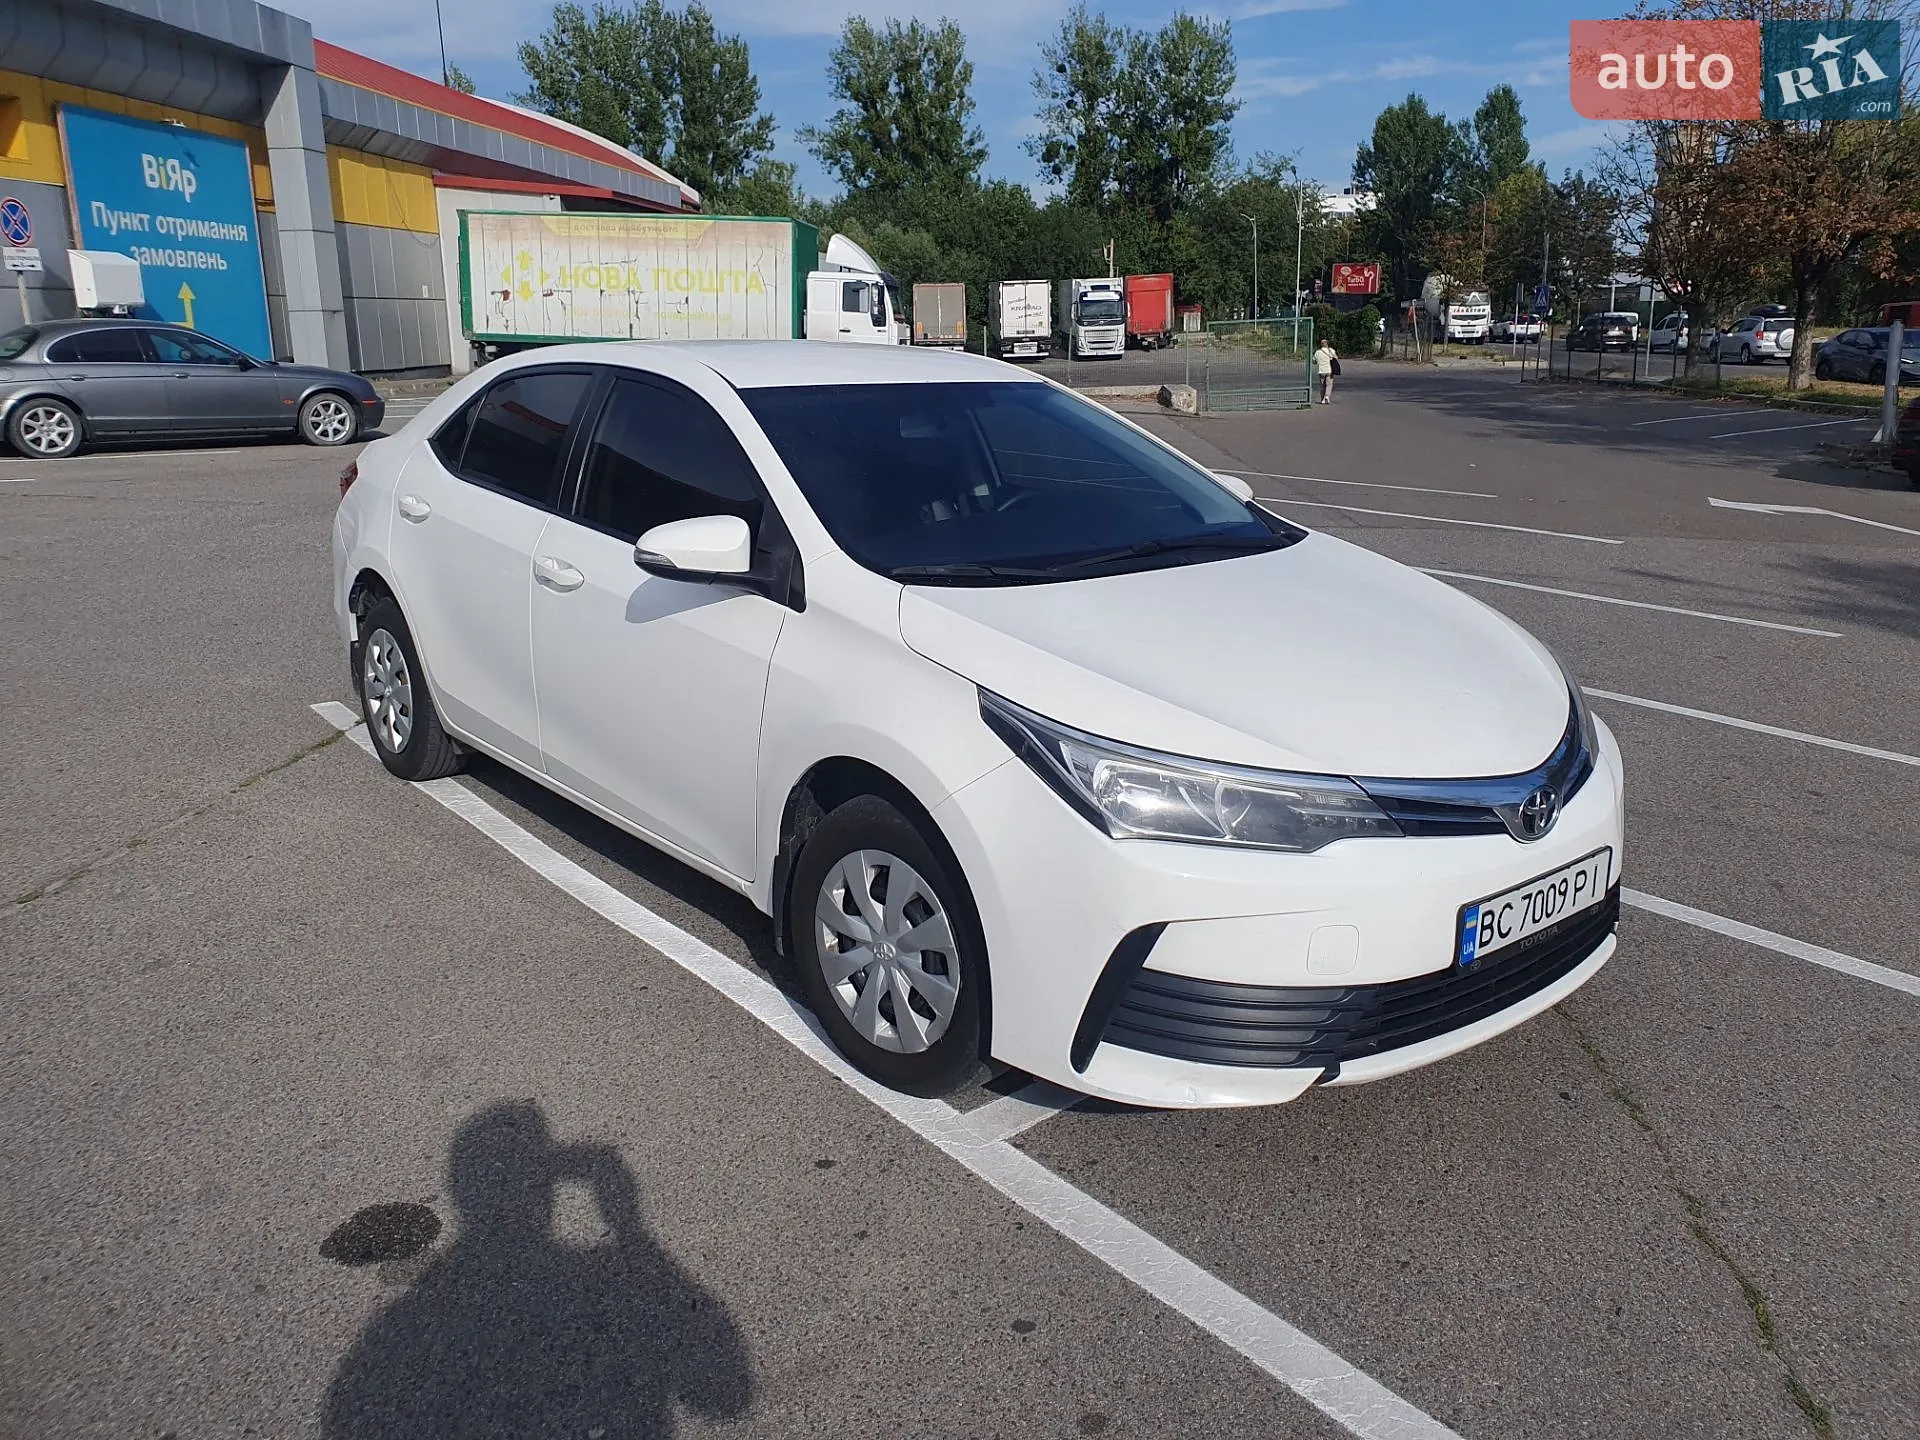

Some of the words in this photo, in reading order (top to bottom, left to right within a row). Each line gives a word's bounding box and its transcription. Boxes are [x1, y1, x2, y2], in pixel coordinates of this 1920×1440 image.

[91, 201, 150, 235] Пункт
[155, 215, 248, 242] отримання
[130, 246, 228, 270] замовлень
[560, 265, 643, 290] НОВА
[653, 268, 764, 295] ПОШТА
[1479, 902, 1513, 949] BC
[1519, 877, 1569, 933] 7009
[1572, 864, 1599, 907] PI
[1463, 941, 1474, 955] UA
[1520, 926, 1559, 951] TOYOTA
